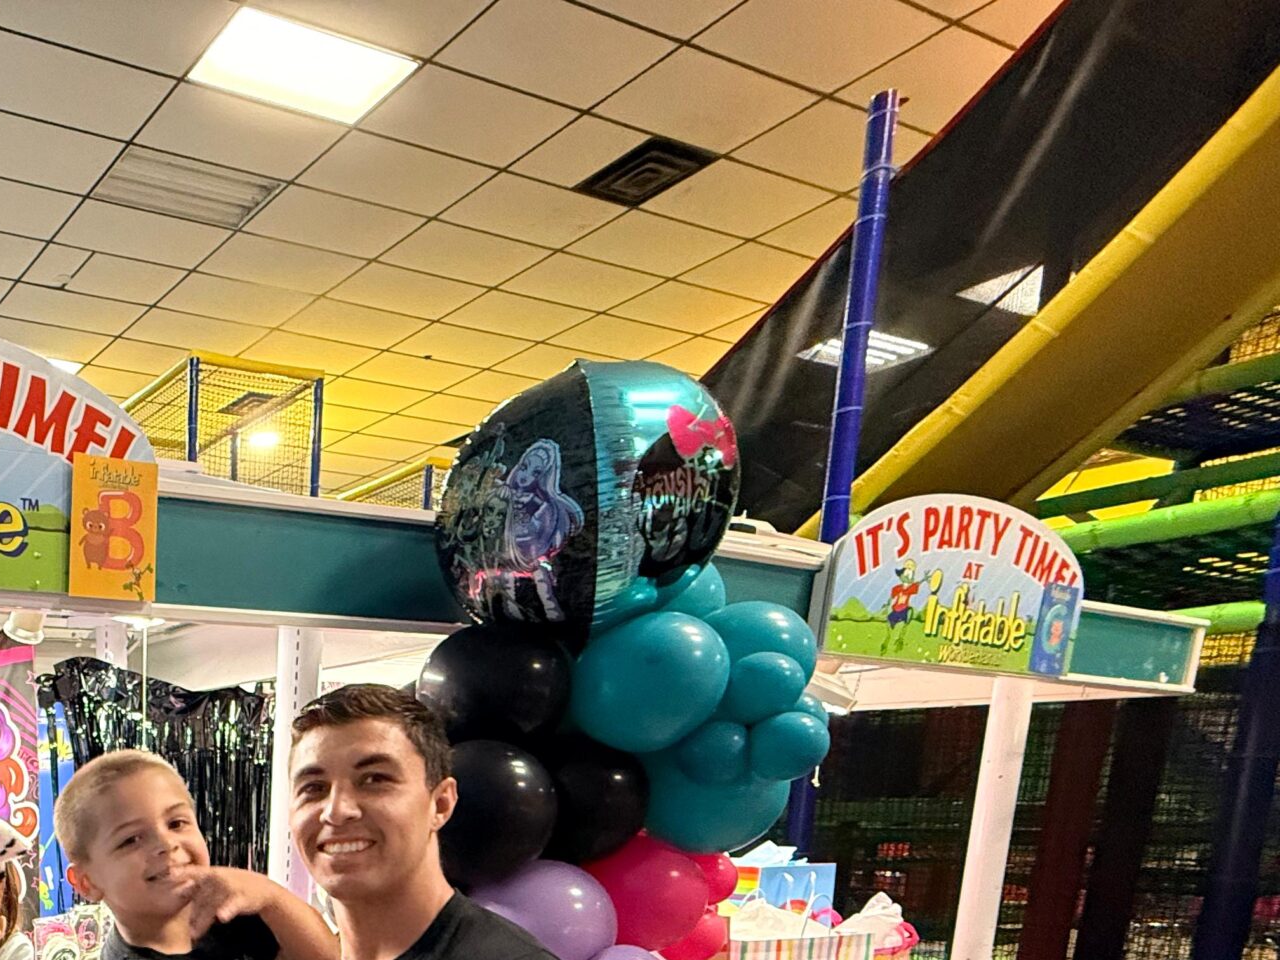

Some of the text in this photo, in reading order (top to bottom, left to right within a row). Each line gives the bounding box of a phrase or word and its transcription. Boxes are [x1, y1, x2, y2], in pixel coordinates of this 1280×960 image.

[98, 490, 145, 571] B
[855, 512, 910, 576] IT'S
[922, 506, 1012, 556] PARTY
[962, 562, 984, 581] AT
